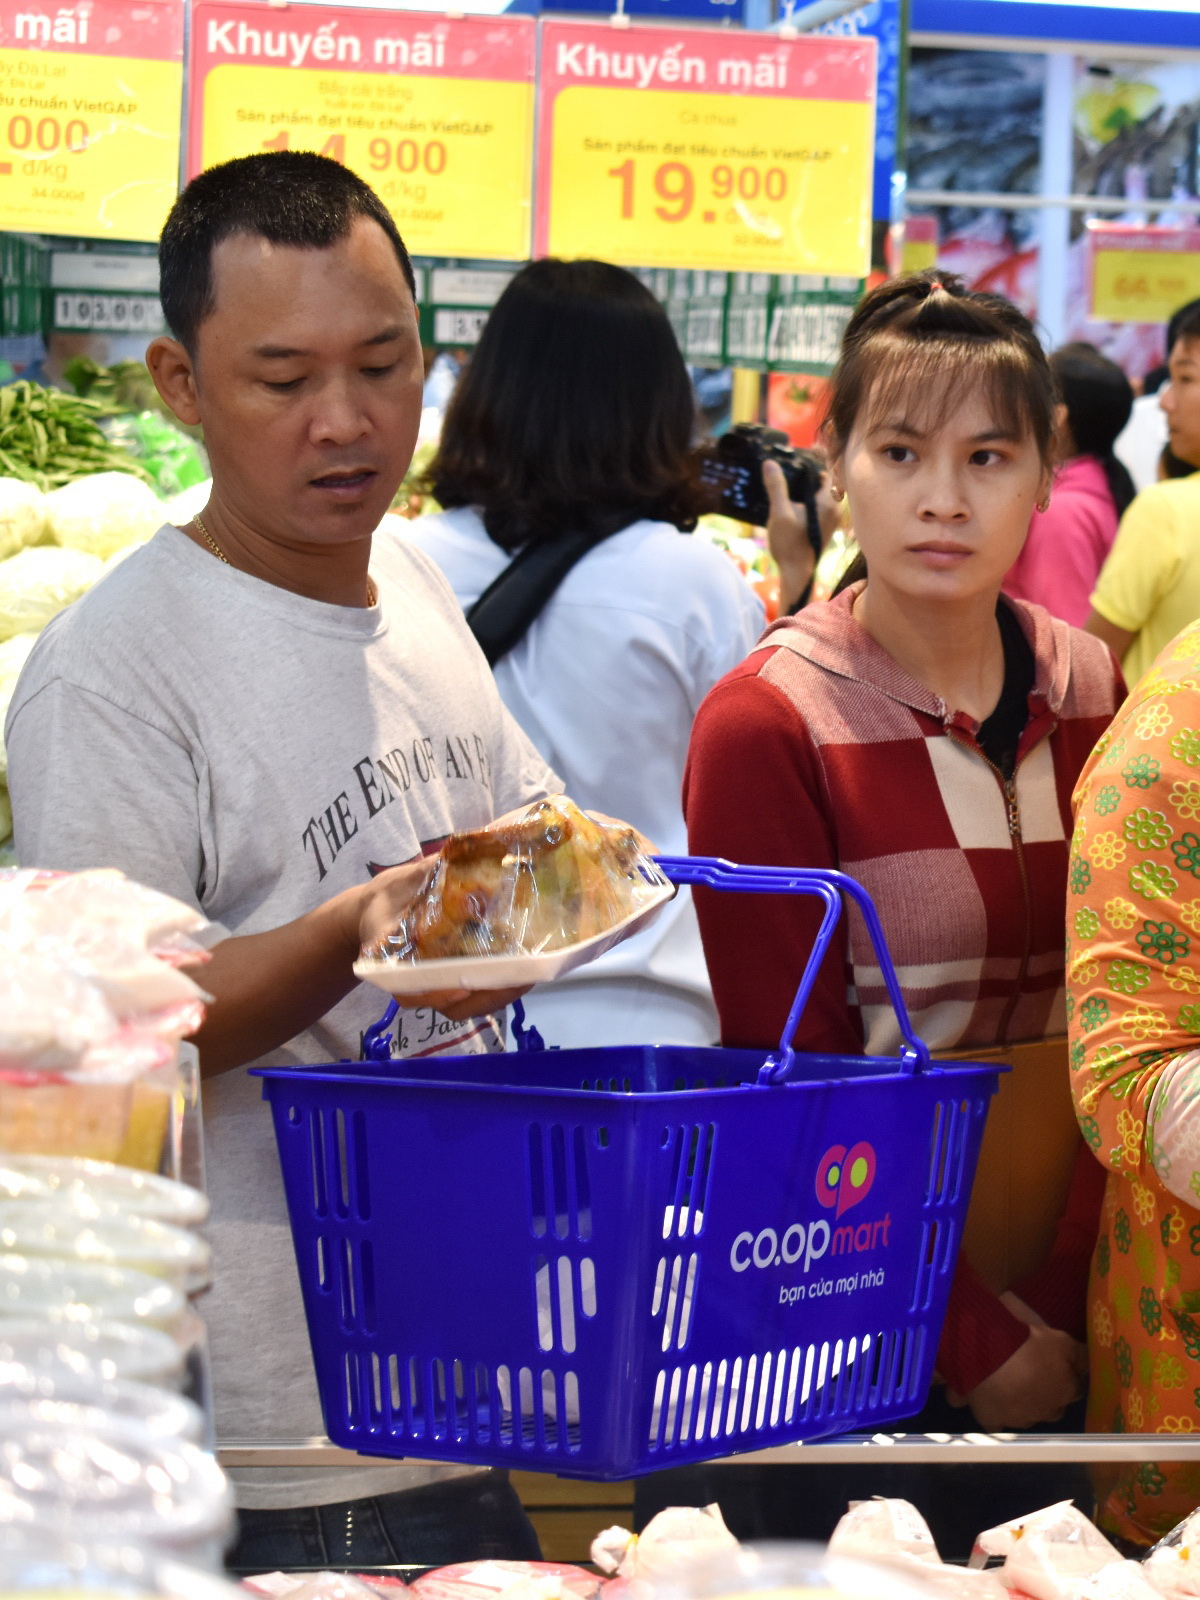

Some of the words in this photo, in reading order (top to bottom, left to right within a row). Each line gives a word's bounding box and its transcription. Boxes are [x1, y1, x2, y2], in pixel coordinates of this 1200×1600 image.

[207, 19, 361, 66] Khuyến
[374, 28, 446, 68] mãi
[556, 42, 706, 88] Khuyến
[718, 51, 788, 88] mãi
[73, 99, 138, 114] VietGAP
[302, 791, 358, 882] THE
[353, 748, 411, 819] END
[412, 737, 437, 783] OF
[446, 735, 475, 780] AN
[779, 1286, 806, 1307] bạn
[808, 1277, 834, 1299] của
[836, 1273, 858, 1296] mọi
[860, 1267, 885, 1289] nhà
